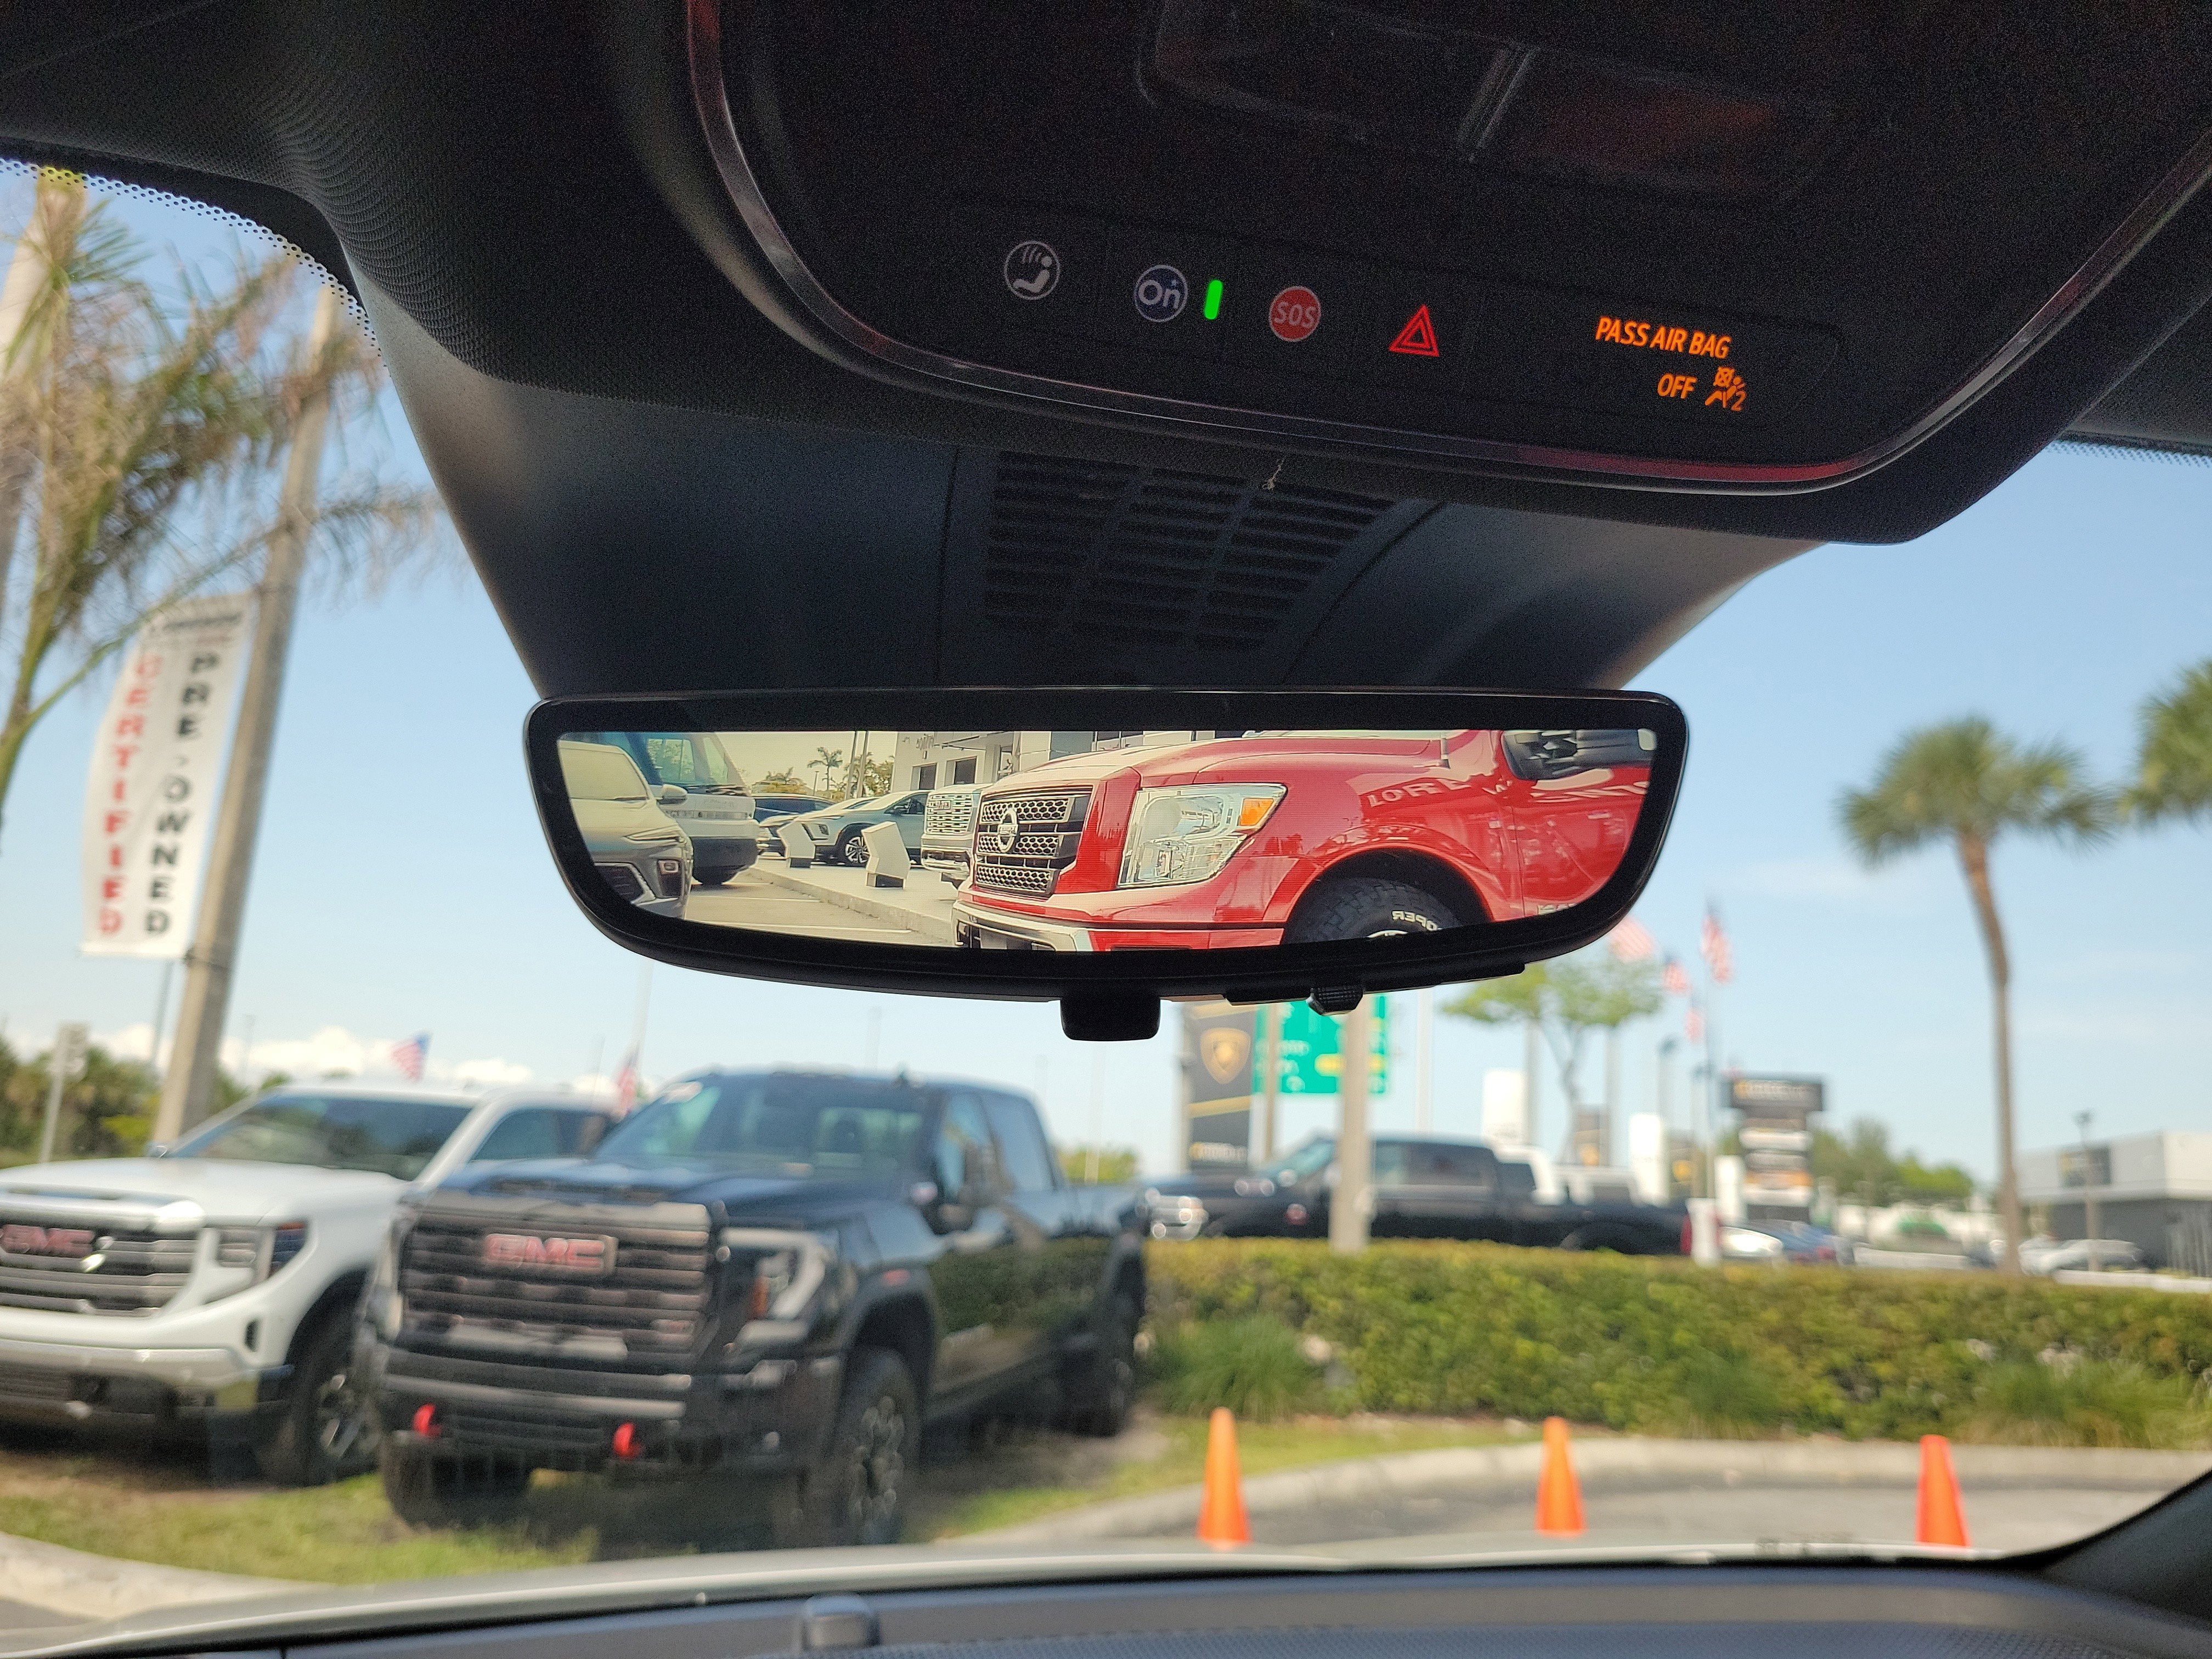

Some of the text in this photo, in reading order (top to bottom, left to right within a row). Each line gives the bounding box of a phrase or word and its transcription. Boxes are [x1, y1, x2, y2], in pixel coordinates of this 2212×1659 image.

[1138, 279, 1180, 309] On
[1274, 301, 1317, 329] SOS
[1595, 317, 1732, 359] PASS AIR BAG
[1657, 373, 1697, 399] OFF
[98, 653, 162, 936] CERTIFIED
[483, 1234, 604, 1267] GMC
